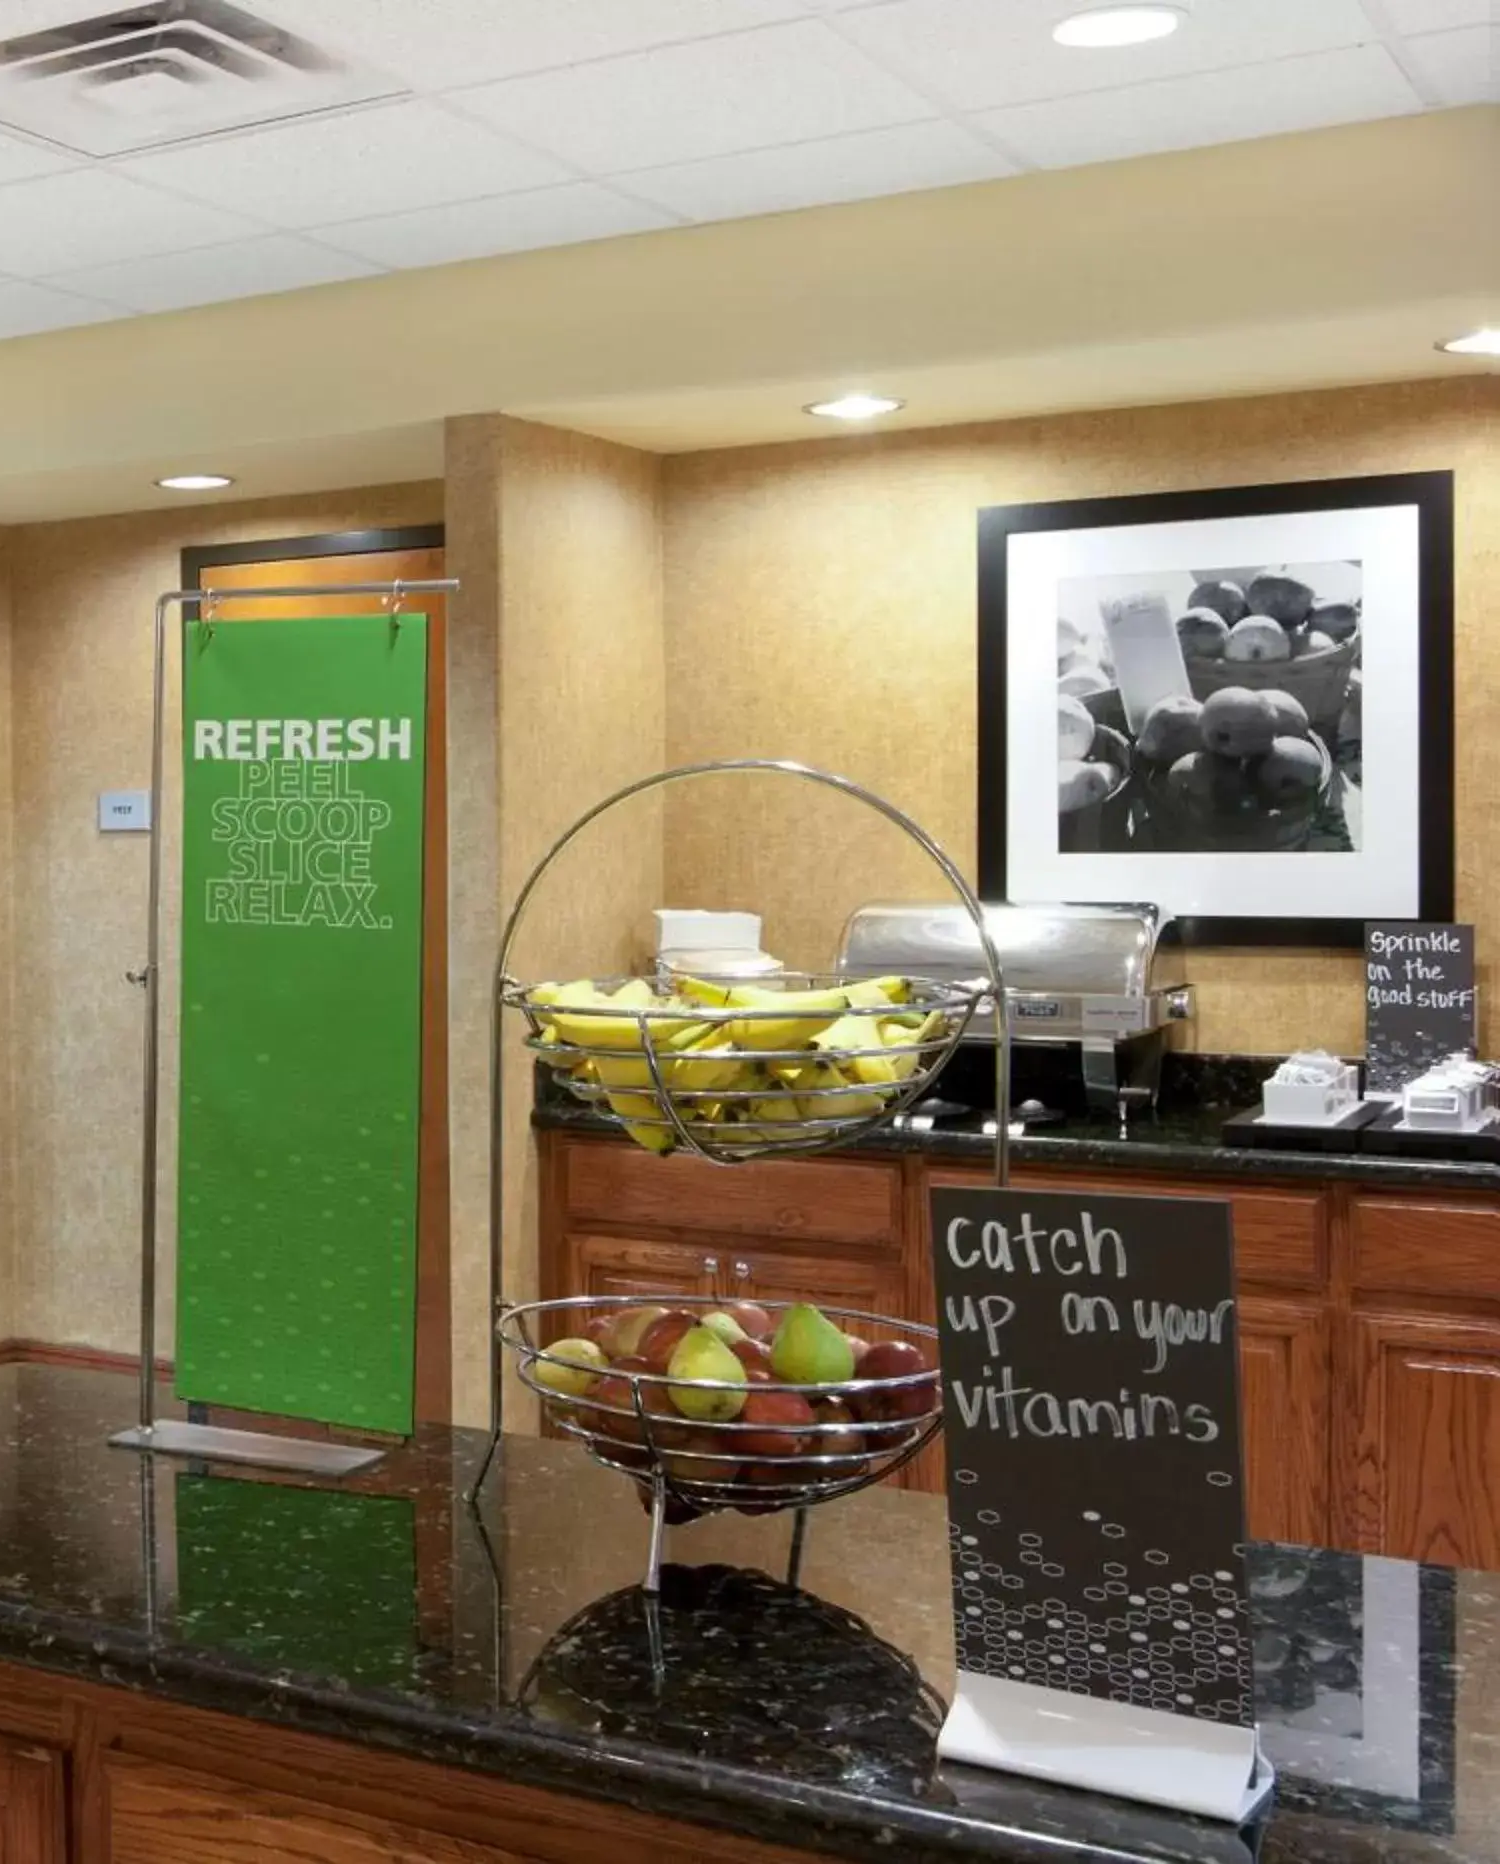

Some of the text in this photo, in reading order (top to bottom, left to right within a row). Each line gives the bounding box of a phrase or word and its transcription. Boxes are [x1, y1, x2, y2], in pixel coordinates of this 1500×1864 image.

[194, 718, 412, 760] REFRESH
[239, 758, 364, 801] PEEL
[210, 797, 392, 843] SCOOP
[227, 839, 372, 885] SLICE
[205, 879, 394, 930] RELAX.
[1370, 931, 1461, 959] Sprinkle
[1368, 959, 1444, 981] on the
[1367, 986, 1412, 1009] good
[945, 1291, 1234, 1374] up on your
[952, 1366, 1219, 1443] vitamins
